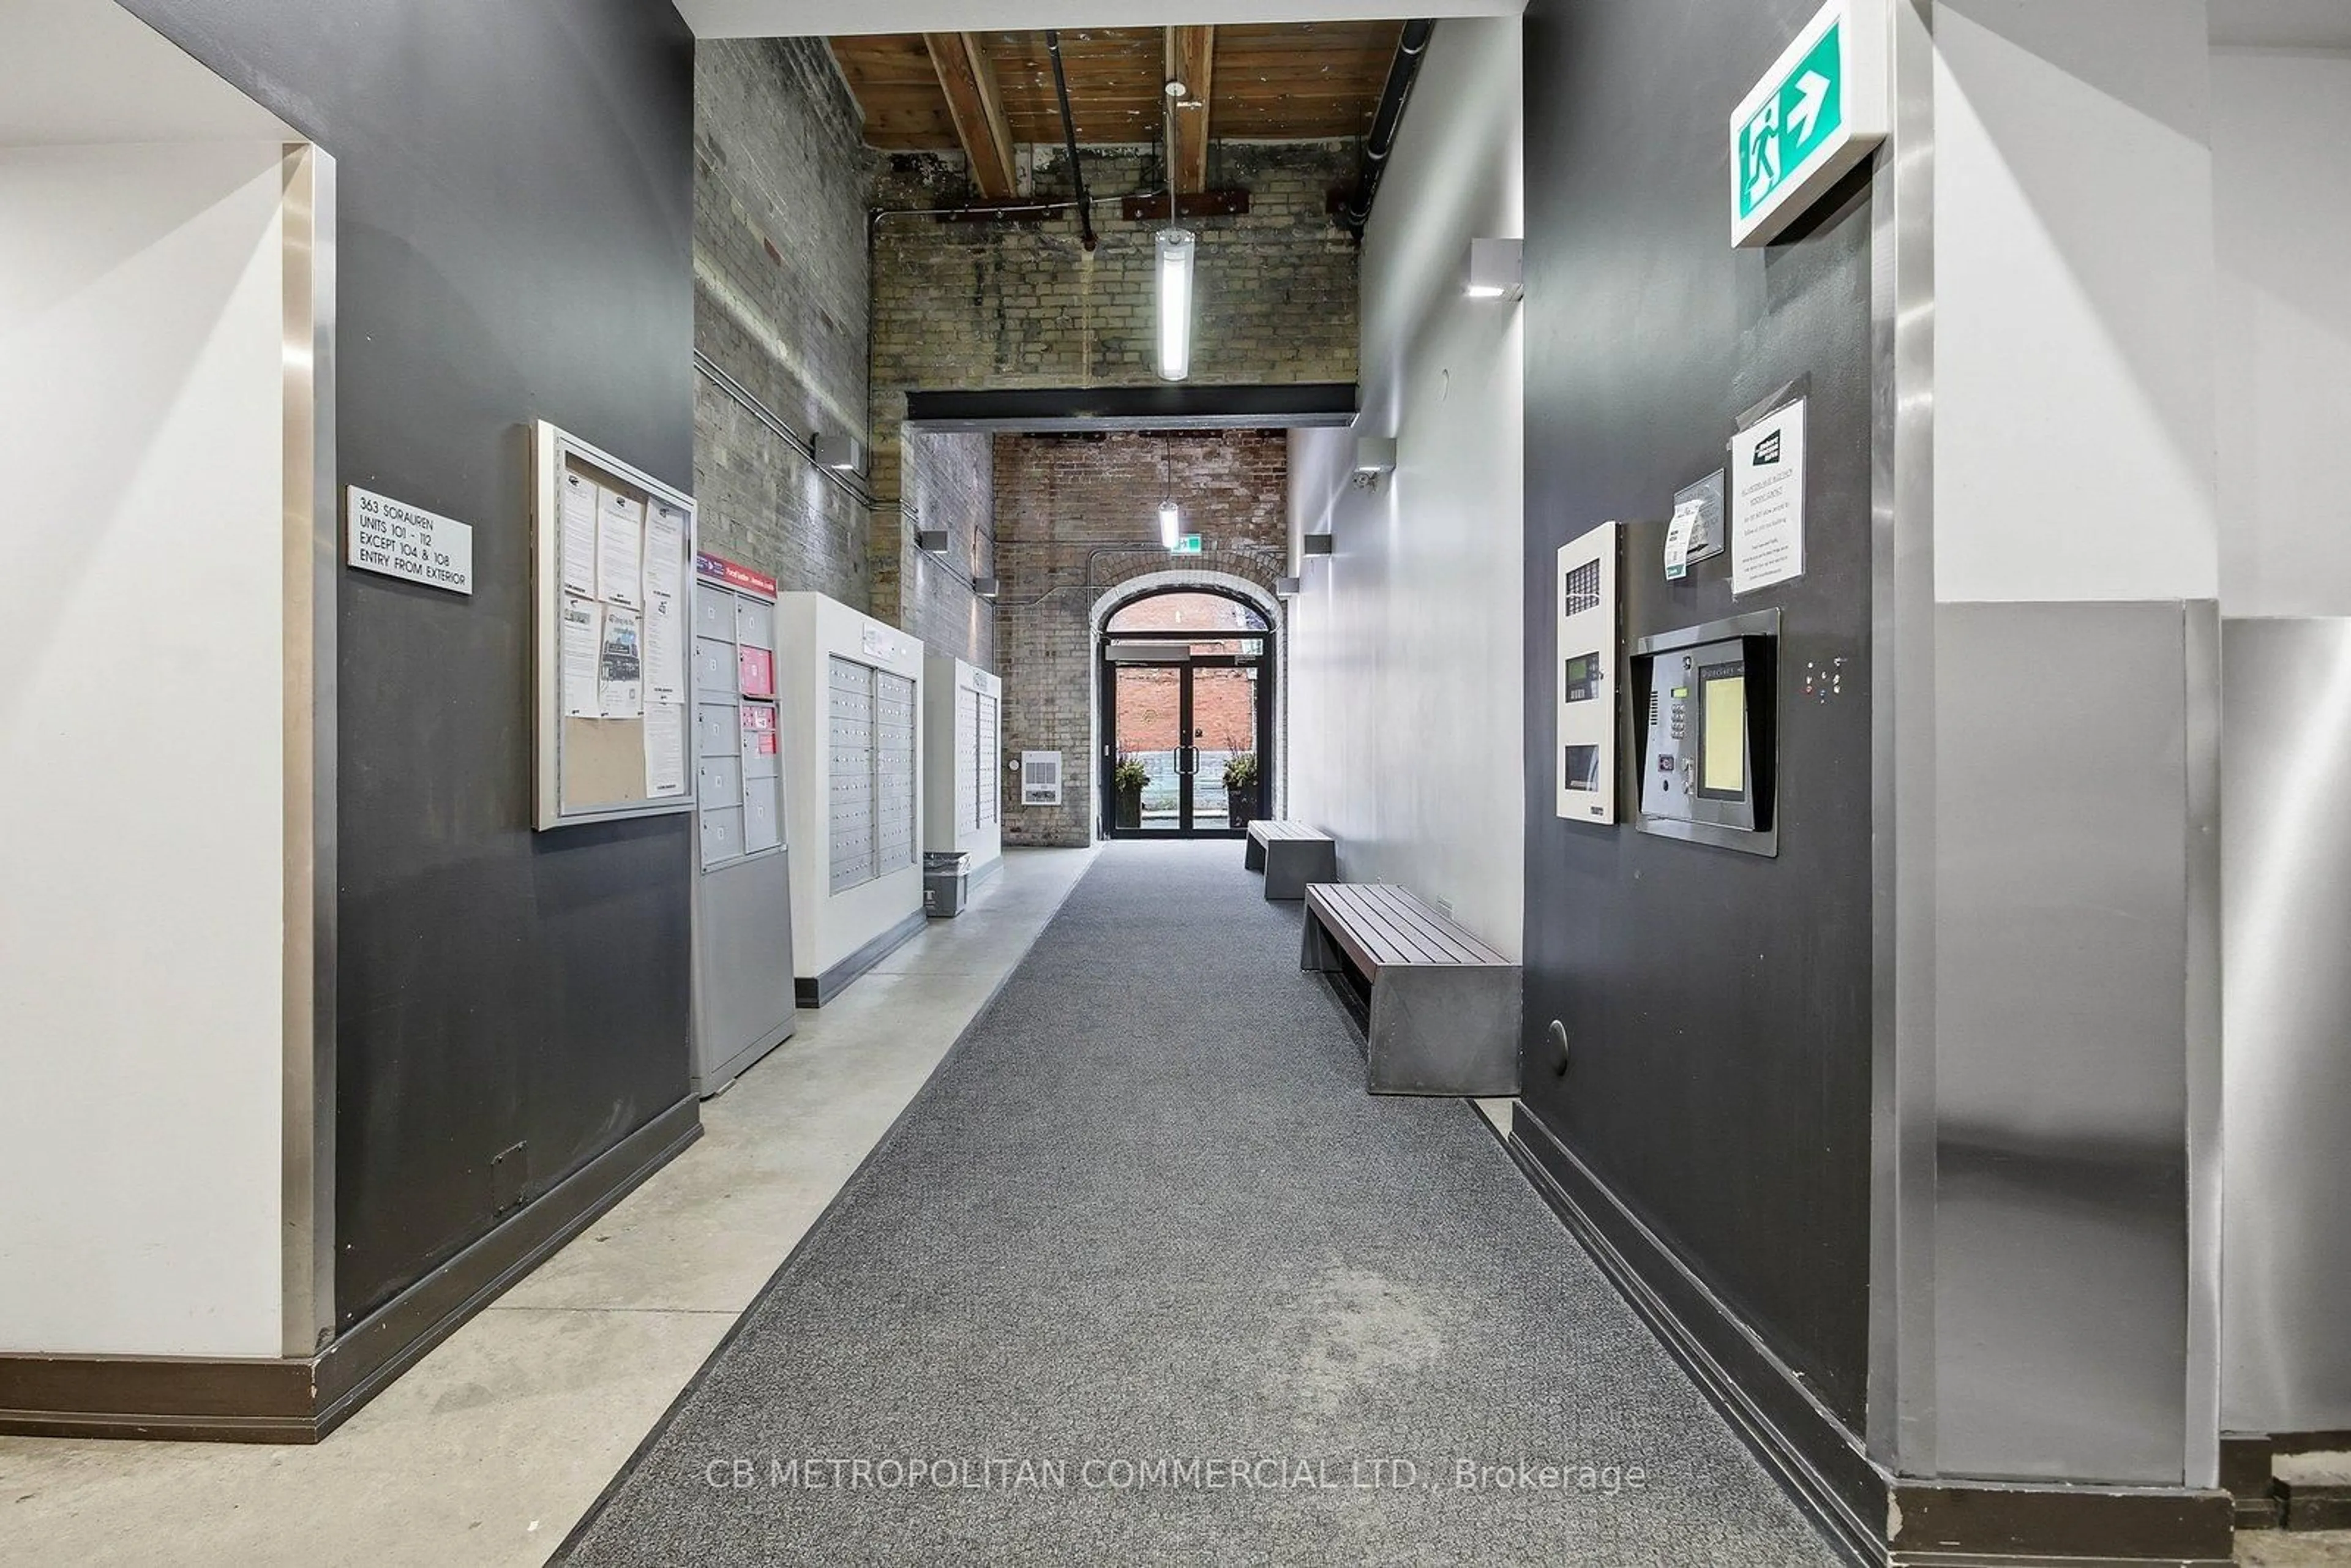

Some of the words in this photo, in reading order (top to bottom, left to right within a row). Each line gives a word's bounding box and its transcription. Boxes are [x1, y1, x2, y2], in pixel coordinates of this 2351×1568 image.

[360, 497, 378, 514] 363
[383, 504, 433, 531] SORAUREN
[360, 515, 387, 533] UNITS
[391, 524, 407, 539] 101
[420, 532, 432, 546] 112
[360, 531, 396, 552] EXCEPT
[400, 542, 417, 558] 104
[422, 550, 429, 560] &
[434, 552, 449, 566] 108
[360, 549, 390, 566] ENTRY
[395, 558, 422, 575] FROM
[427, 566, 465, 585] EXTERIOR
